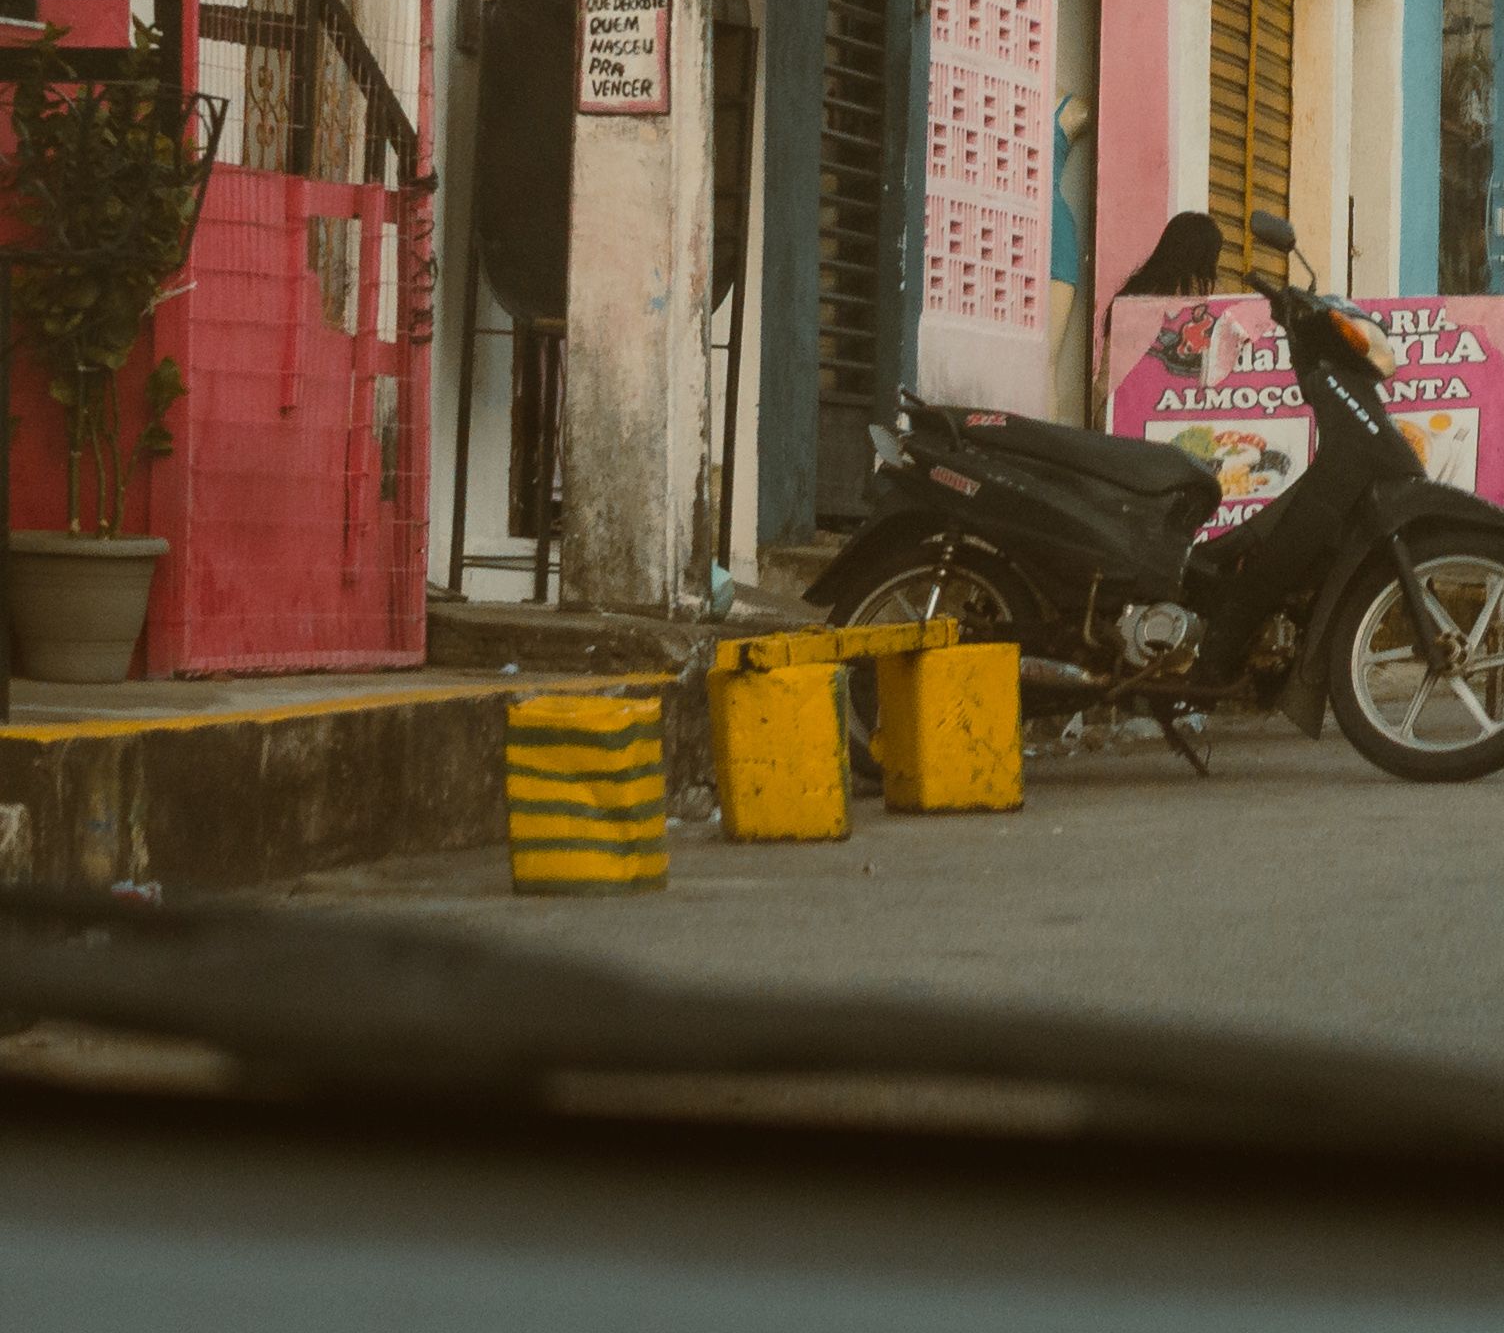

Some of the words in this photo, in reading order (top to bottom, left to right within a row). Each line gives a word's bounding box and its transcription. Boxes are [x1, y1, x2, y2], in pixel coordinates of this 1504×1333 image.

[589, 16, 640, 36] QUEM
[589, 38, 655, 57] NASCEU
[588, 57, 625, 77] PRA
[591, 78, 653, 98] VENCER
[1155, 385, 1304, 416] ALMOÇO
